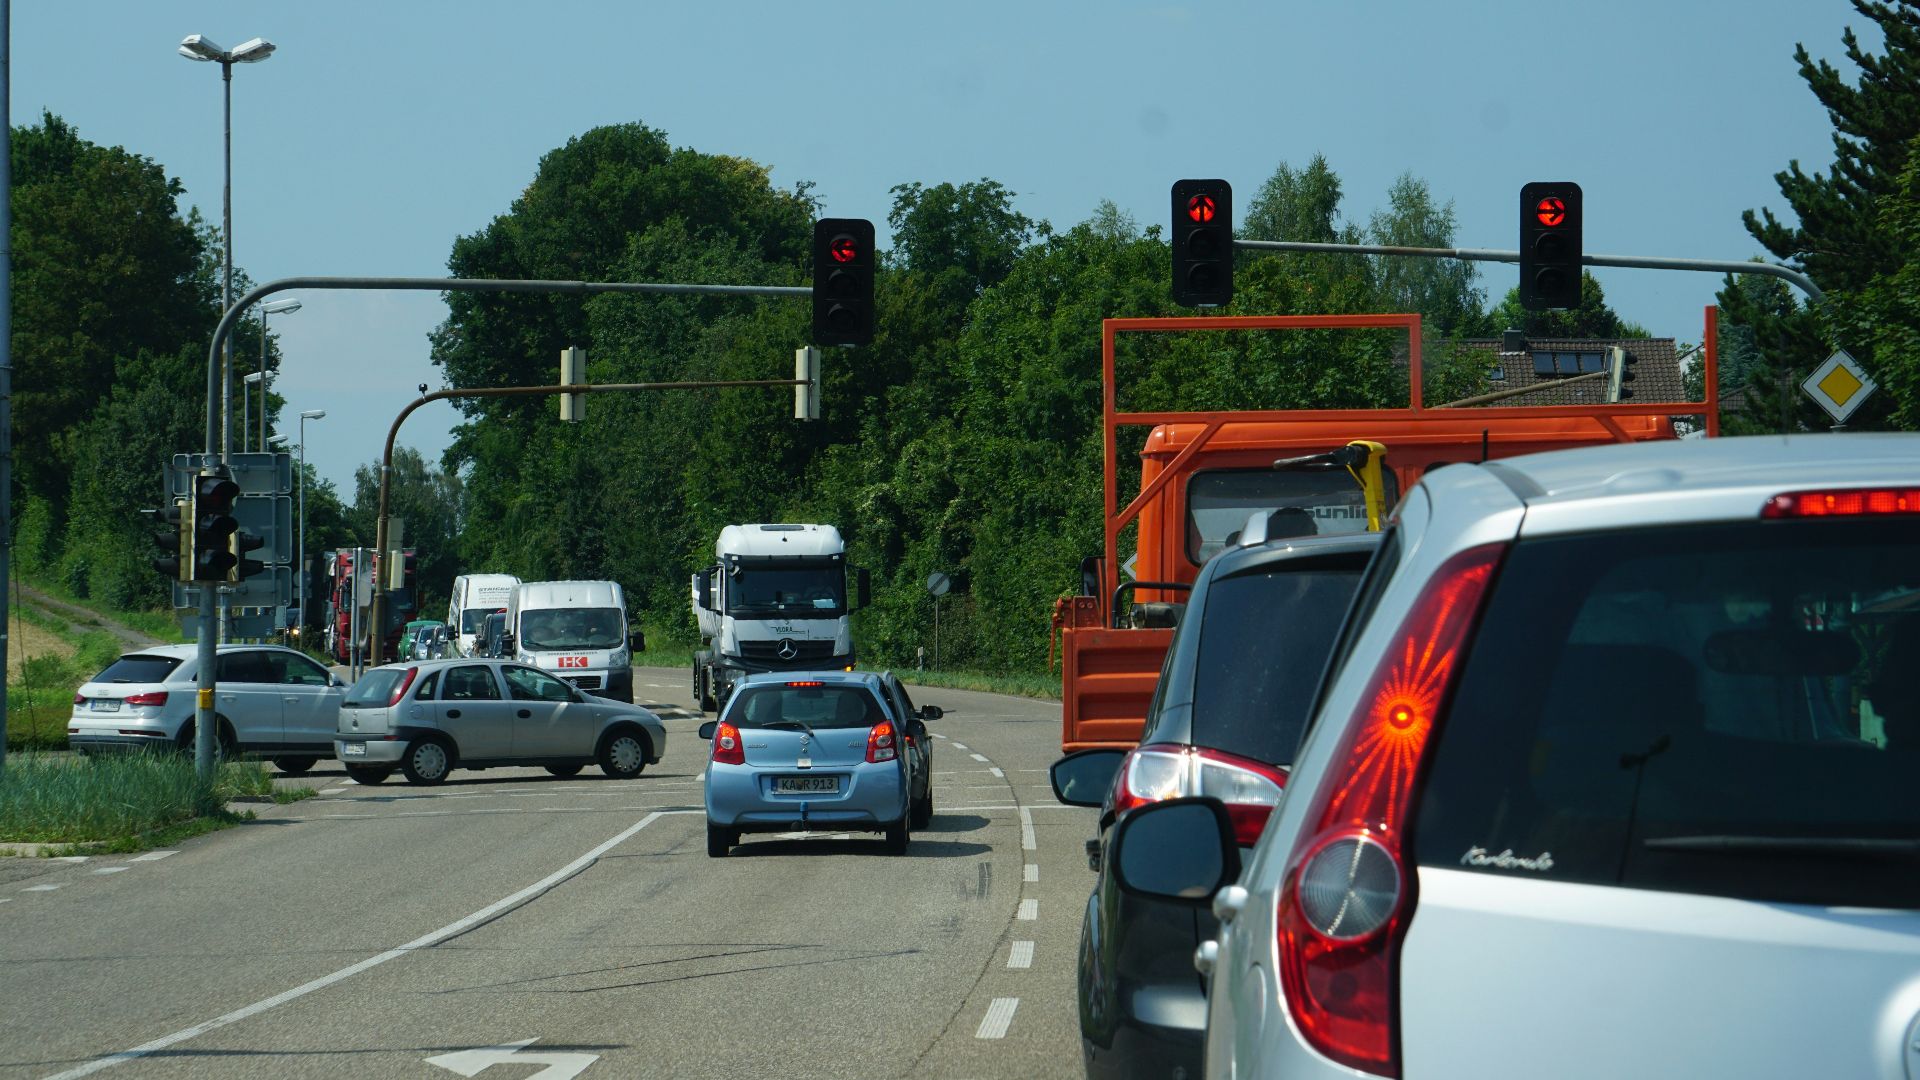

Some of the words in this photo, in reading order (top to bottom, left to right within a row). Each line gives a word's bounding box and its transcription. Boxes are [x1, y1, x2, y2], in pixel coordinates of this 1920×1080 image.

[782, 780, 796, 790] KA
[803, 780, 810, 790] R
[813, 779, 834, 790] 913
